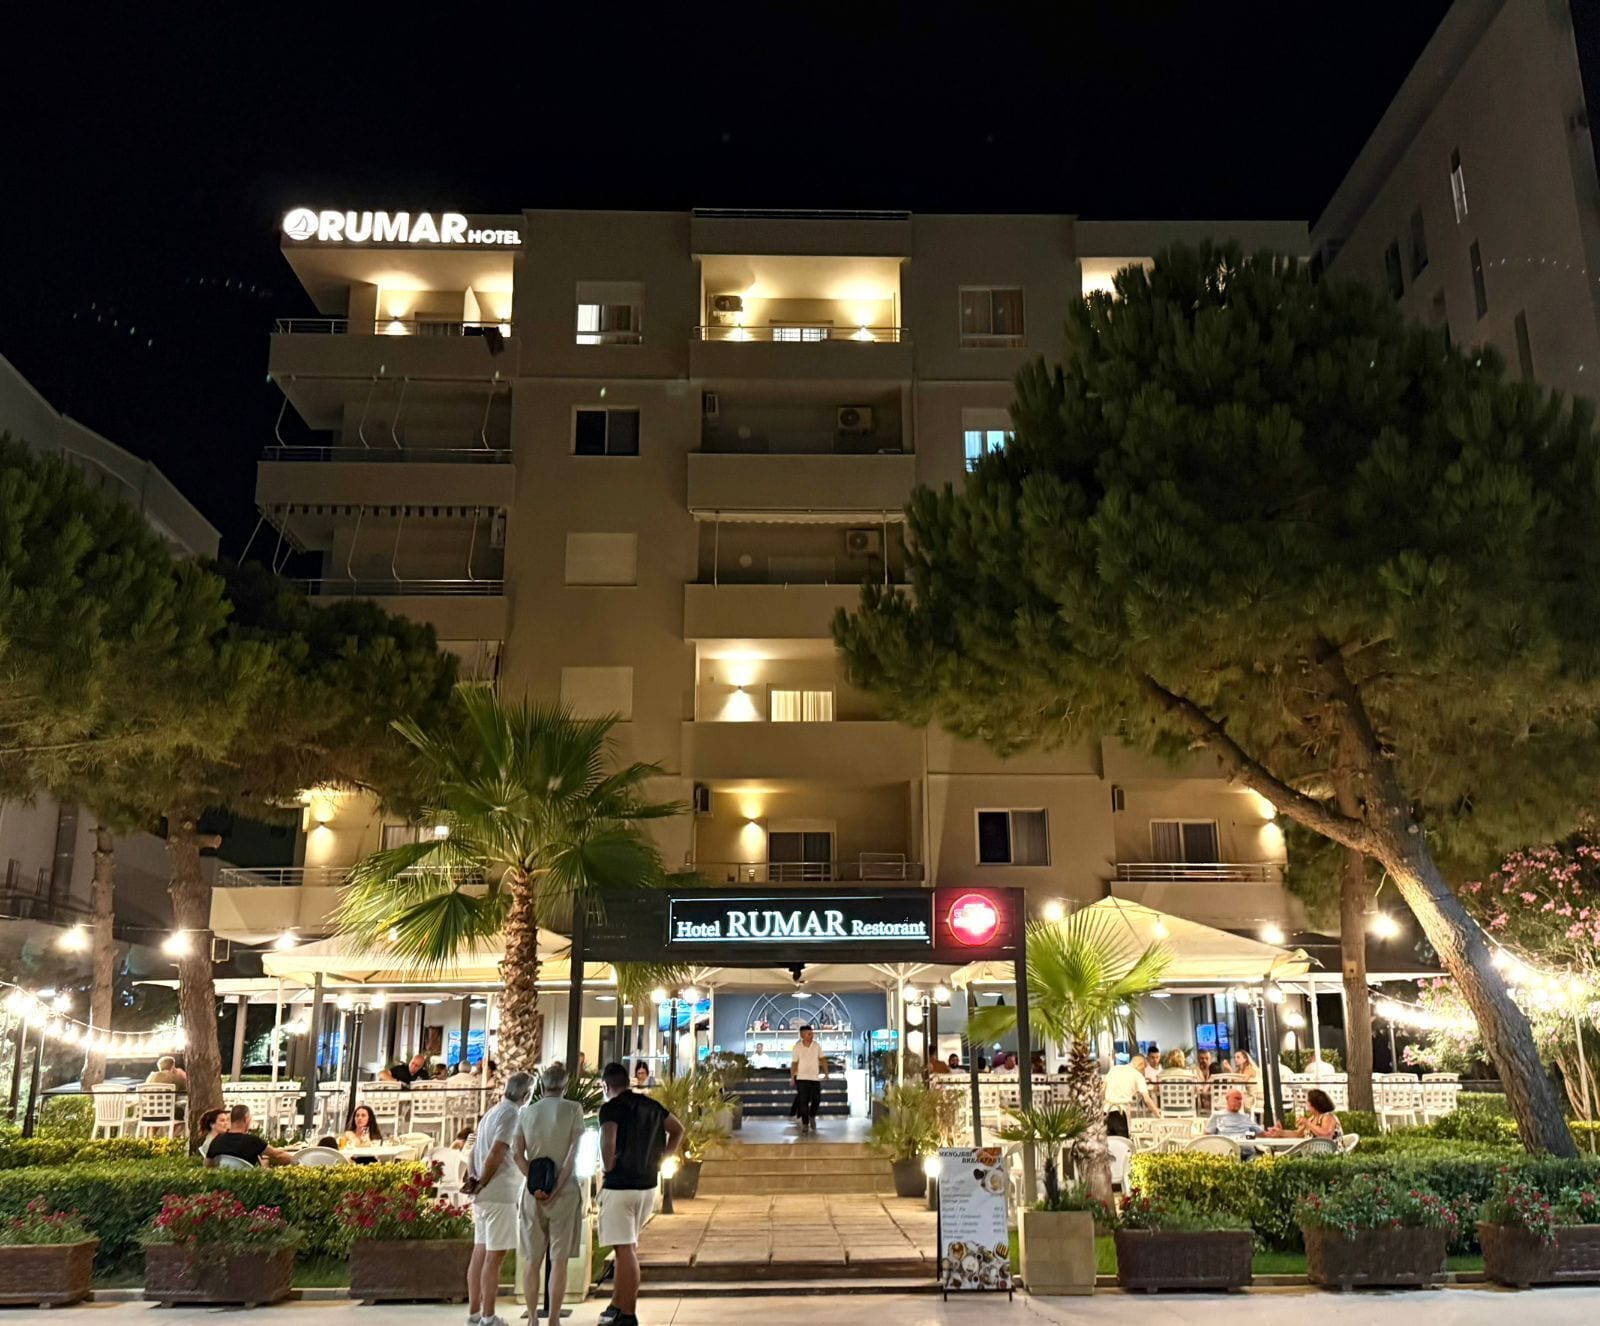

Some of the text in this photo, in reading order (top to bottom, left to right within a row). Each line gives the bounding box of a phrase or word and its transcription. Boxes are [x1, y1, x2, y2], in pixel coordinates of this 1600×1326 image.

[318, 210, 522, 245] RUMAR HOTEL
[677, 910, 926, 938] Hotel RUMAR Restorant
